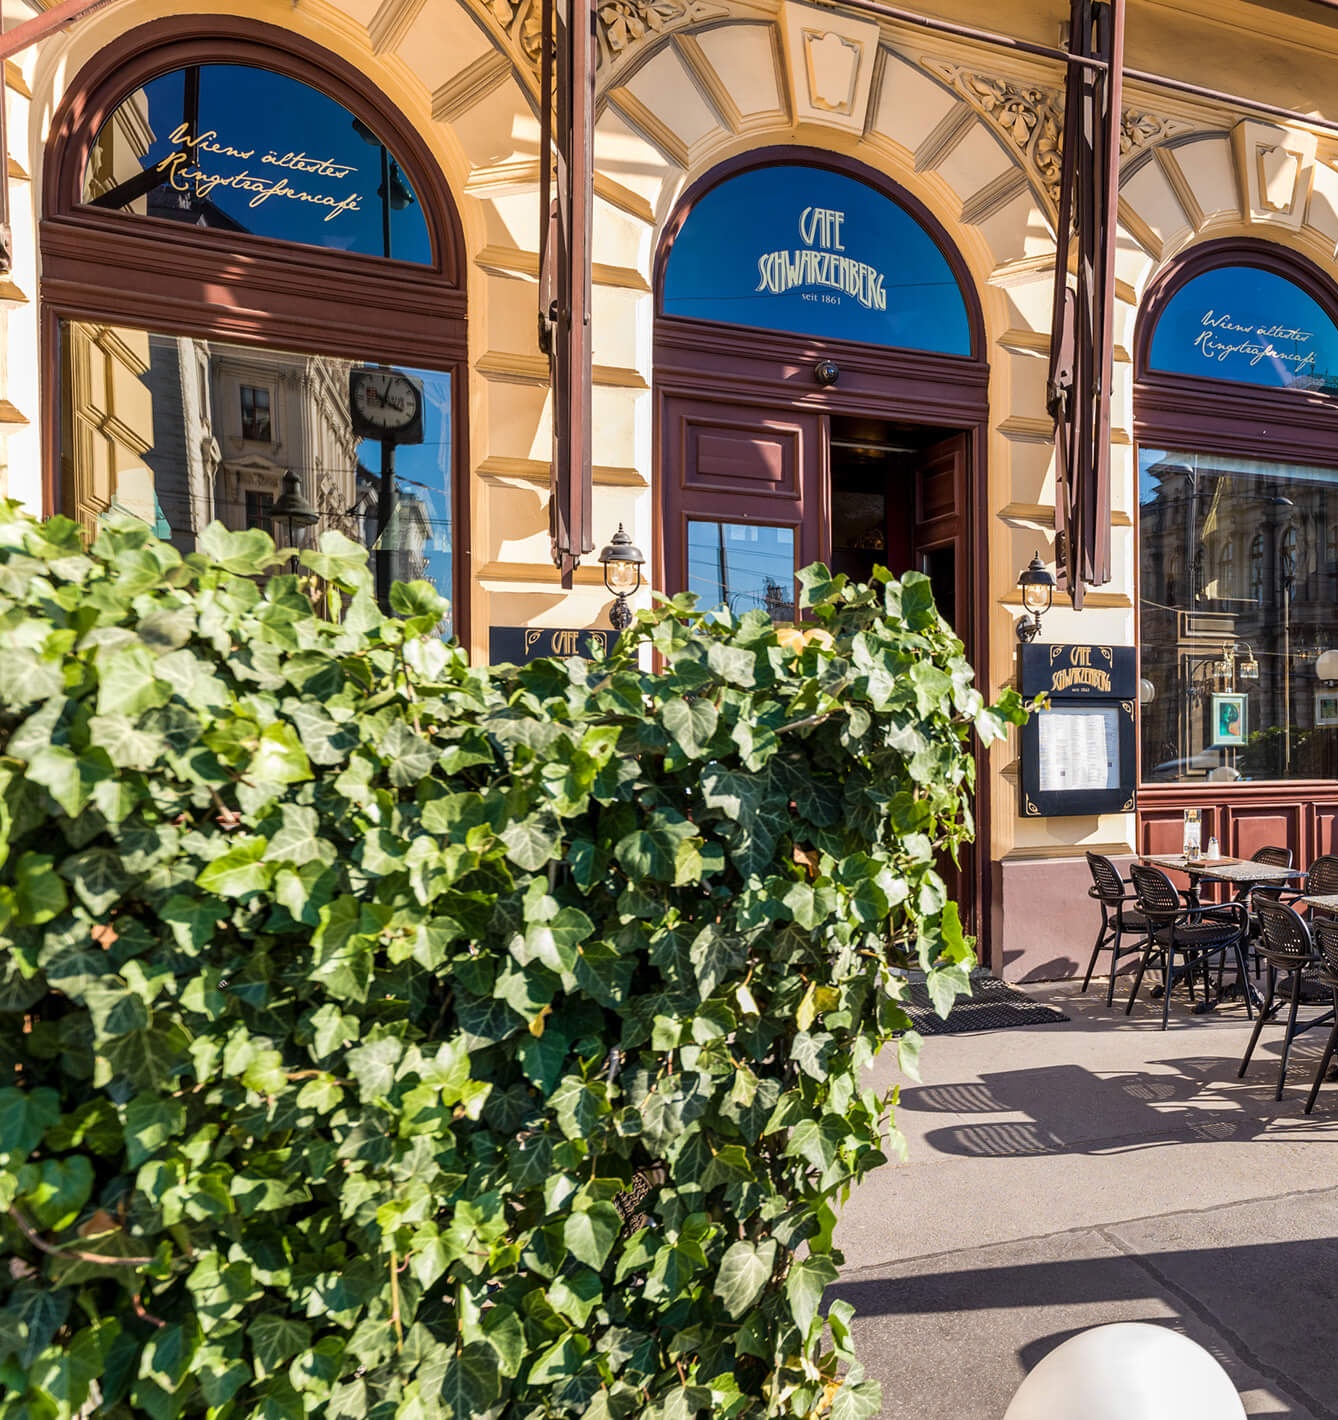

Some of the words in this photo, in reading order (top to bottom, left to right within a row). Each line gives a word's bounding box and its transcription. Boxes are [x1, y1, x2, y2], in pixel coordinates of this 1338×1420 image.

[168, 122, 254, 159] Wiens
[261, 150, 359, 178] ältestes
[798, 206, 845, 252] CAFE
[754, 249, 887, 312] SCHWARZENBERG
[801, 293, 818, 302] seit
[821, 294, 841, 305] 1861
[1201, 310, 1253, 333] Wiens
[550, 631, 580, 655] CAFE
[1070, 646, 1092, 666] CAFE
